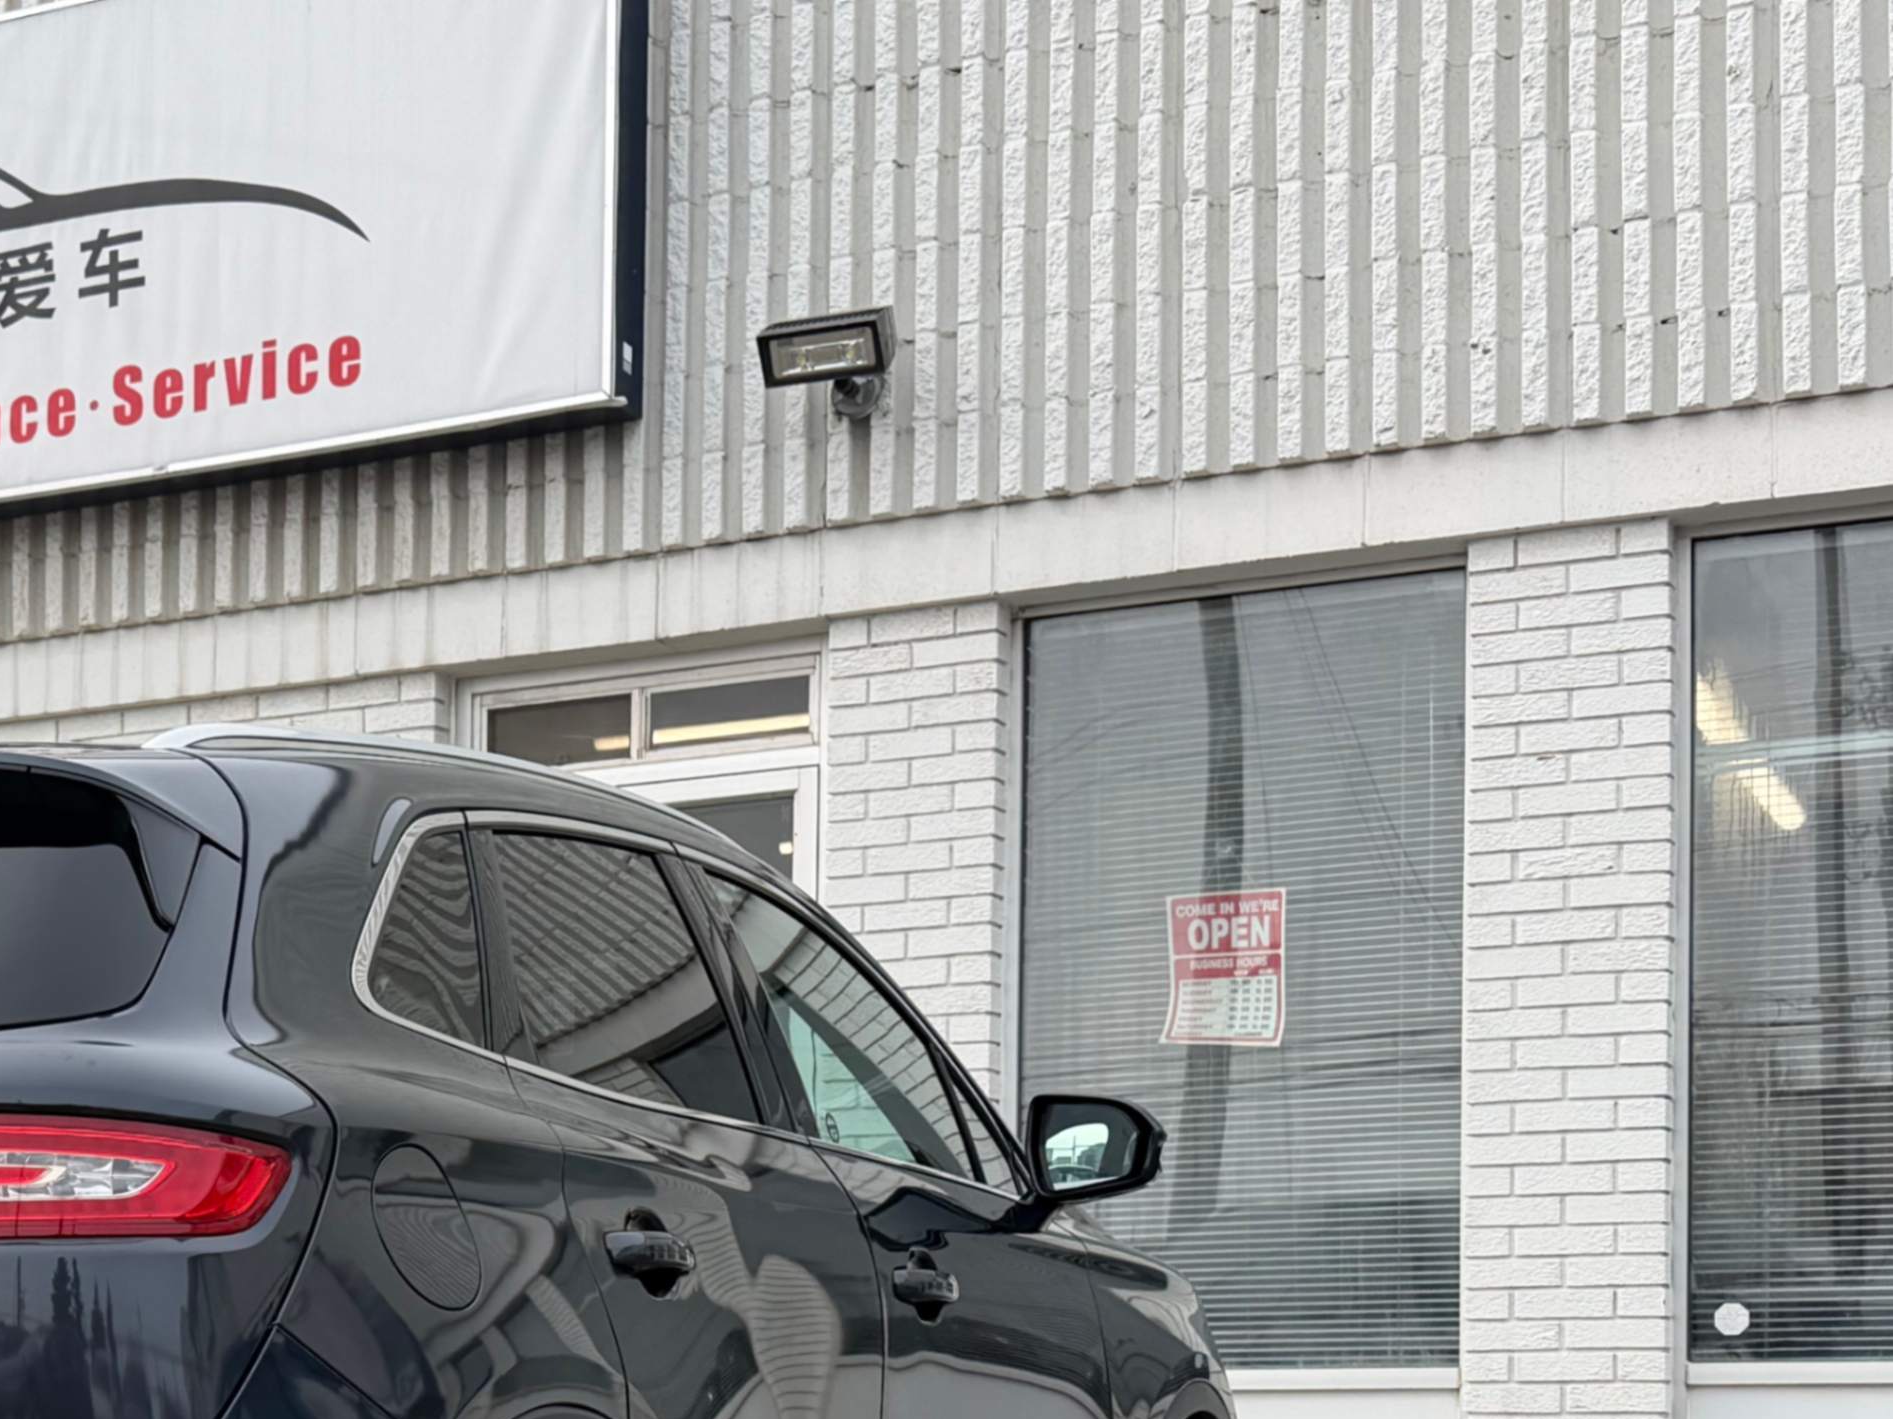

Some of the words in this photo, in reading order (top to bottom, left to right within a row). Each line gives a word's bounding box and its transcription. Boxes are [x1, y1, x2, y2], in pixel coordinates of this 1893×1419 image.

[112, 333, 363, 426] Service
[1175, 901, 1216, 917] COME
[1220, 902, 1235, 915] IN
[1238, 899, 1279, 914] WE'RE
[1187, 915, 1270, 951] OPEN
[1236, 956, 1268, 968] HOURS
